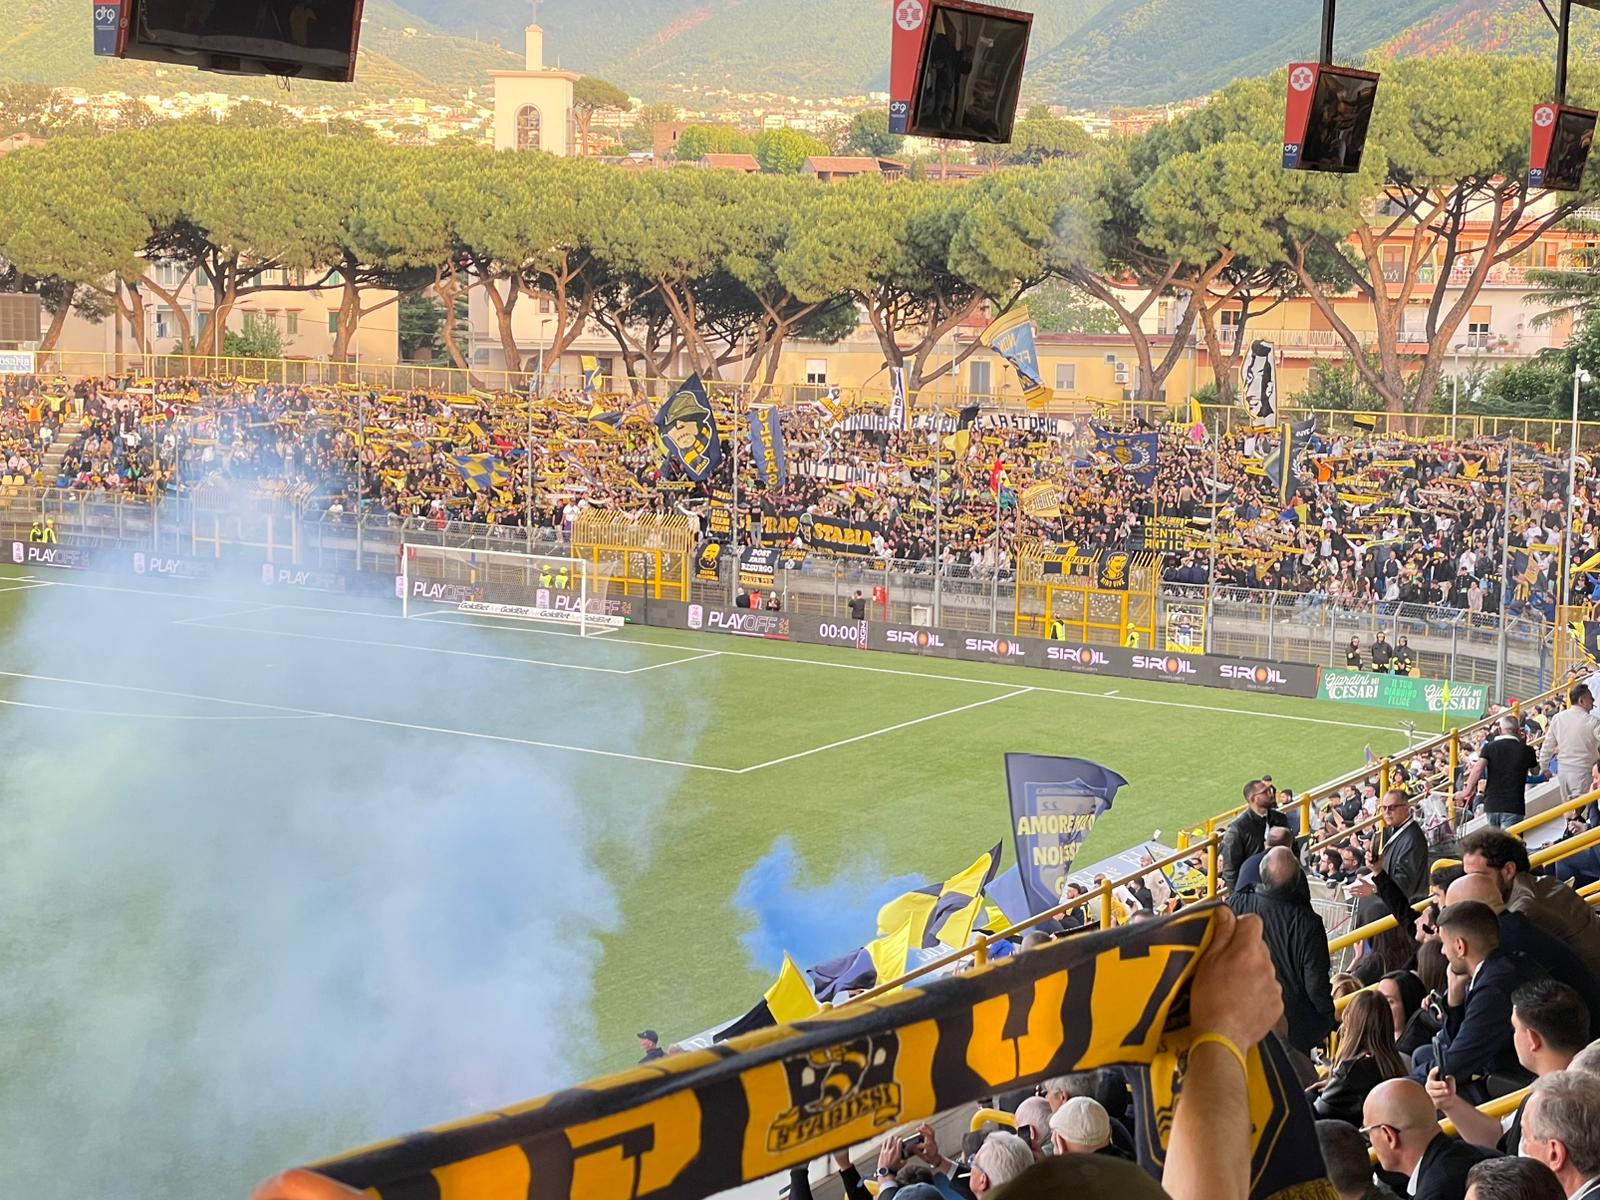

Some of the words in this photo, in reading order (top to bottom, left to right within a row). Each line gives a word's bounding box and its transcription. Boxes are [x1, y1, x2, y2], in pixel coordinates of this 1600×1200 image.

[1011, 414, 1058, 436] STORIA
[813, 523, 872, 547] STABIA
[1144, 528, 1184, 540] CENTR
[708, 611, 777, 632] PLAYOFF
[819, 623, 858, 641] 00:00
[1325, 673, 1369, 689] Giardini
[1329, 685, 1378, 699] CESARI
[1424, 683, 1471, 698] Giadini
[1017, 815, 1074, 836] AMORE
